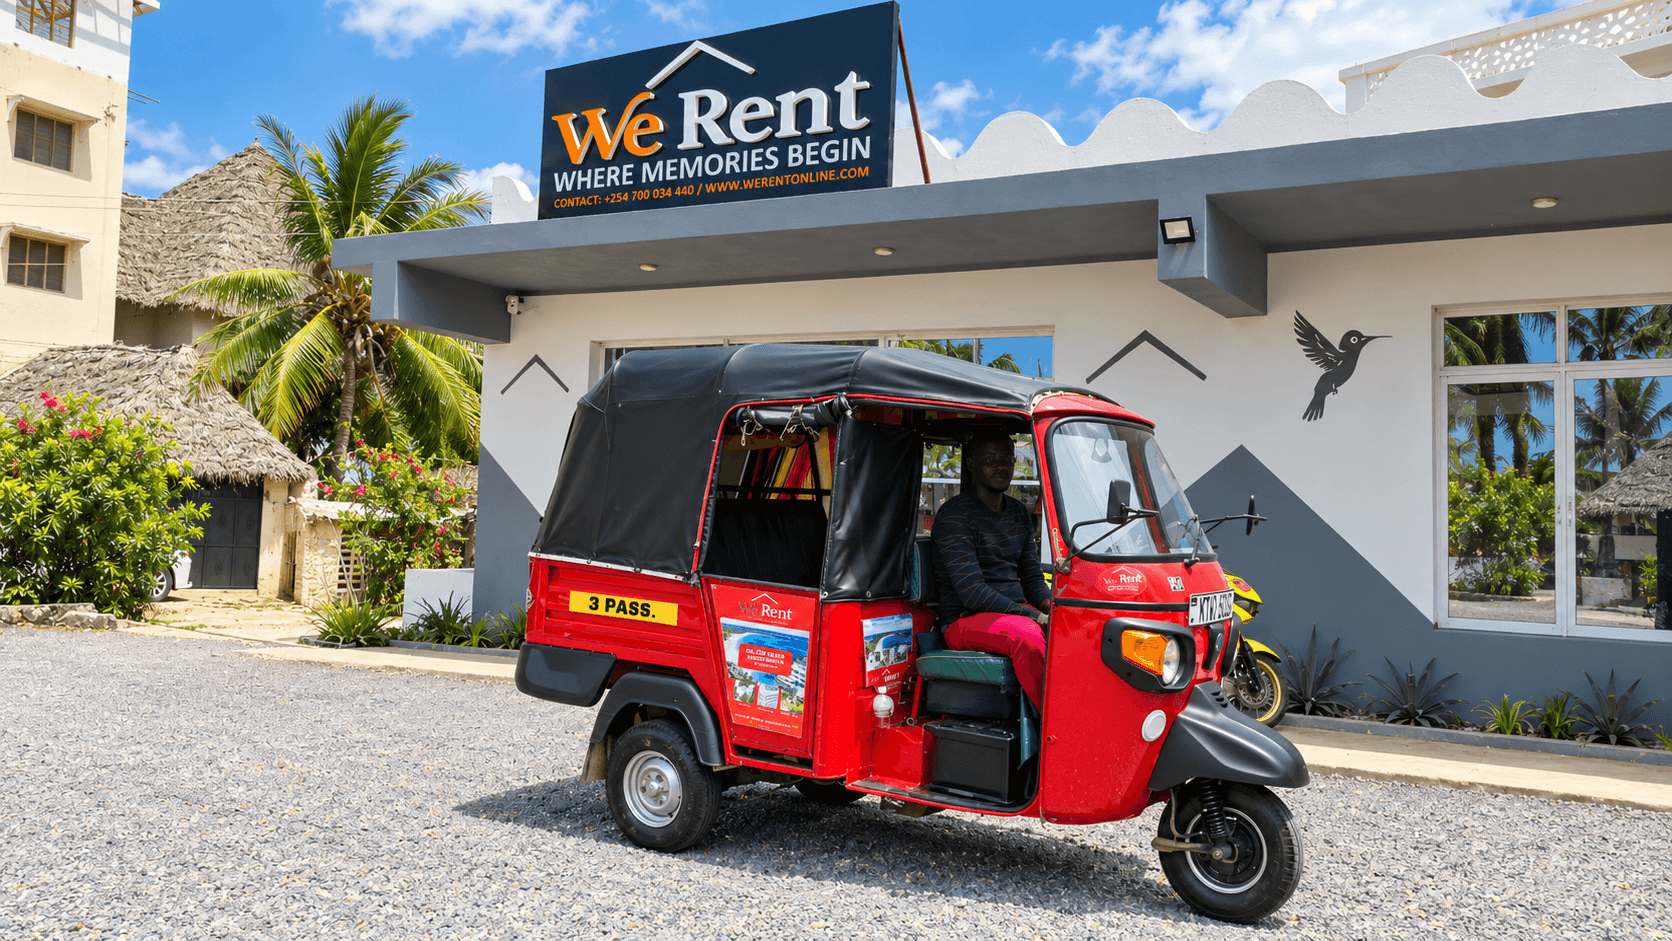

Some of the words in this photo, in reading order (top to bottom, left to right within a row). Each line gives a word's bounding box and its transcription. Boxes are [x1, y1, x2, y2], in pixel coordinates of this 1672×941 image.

[551, 92, 665, 165] We
[677, 71, 871, 150] Rent
[553, 164, 634, 193] WHERE
[641, 146, 779, 184] MEMORIES
[788, 136, 871, 168] BEGIN
[553, 195, 602, 209] CONTACT:
[604, 191, 628, 204] +254
[632, 189, 650, 201] 700
[653, 187, 672, 199] 034
[675, 184, 694, 196] 440
[697, 183, 703, 197] /
[705, 166, 870, 194] WWW.WERENTONLINE.COM
[588, 596, 600, 611] 3
[604, 597, 656, 619] PASS.
[761, 603, 793, 621] Rent
